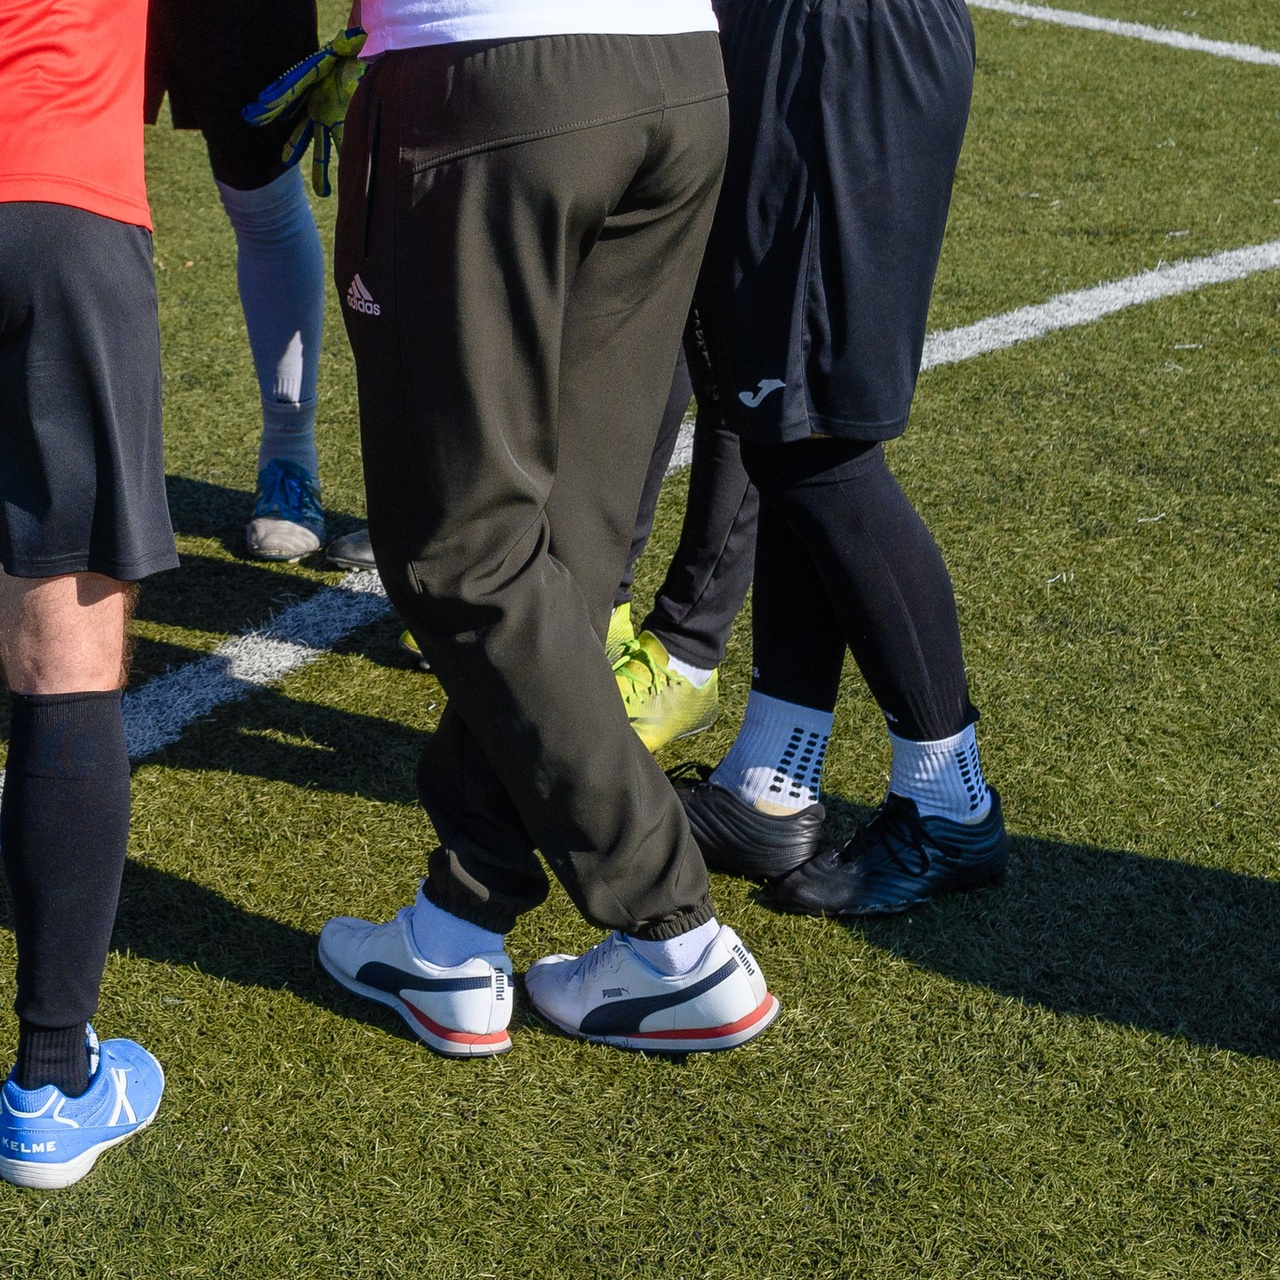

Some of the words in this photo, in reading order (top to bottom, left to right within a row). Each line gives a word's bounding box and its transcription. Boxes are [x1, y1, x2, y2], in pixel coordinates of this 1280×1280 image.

[346, 294, 381, 316] adidas
[602, 987, 623, 999] PUMA
[2, 1136, 57, 1154] KELME
